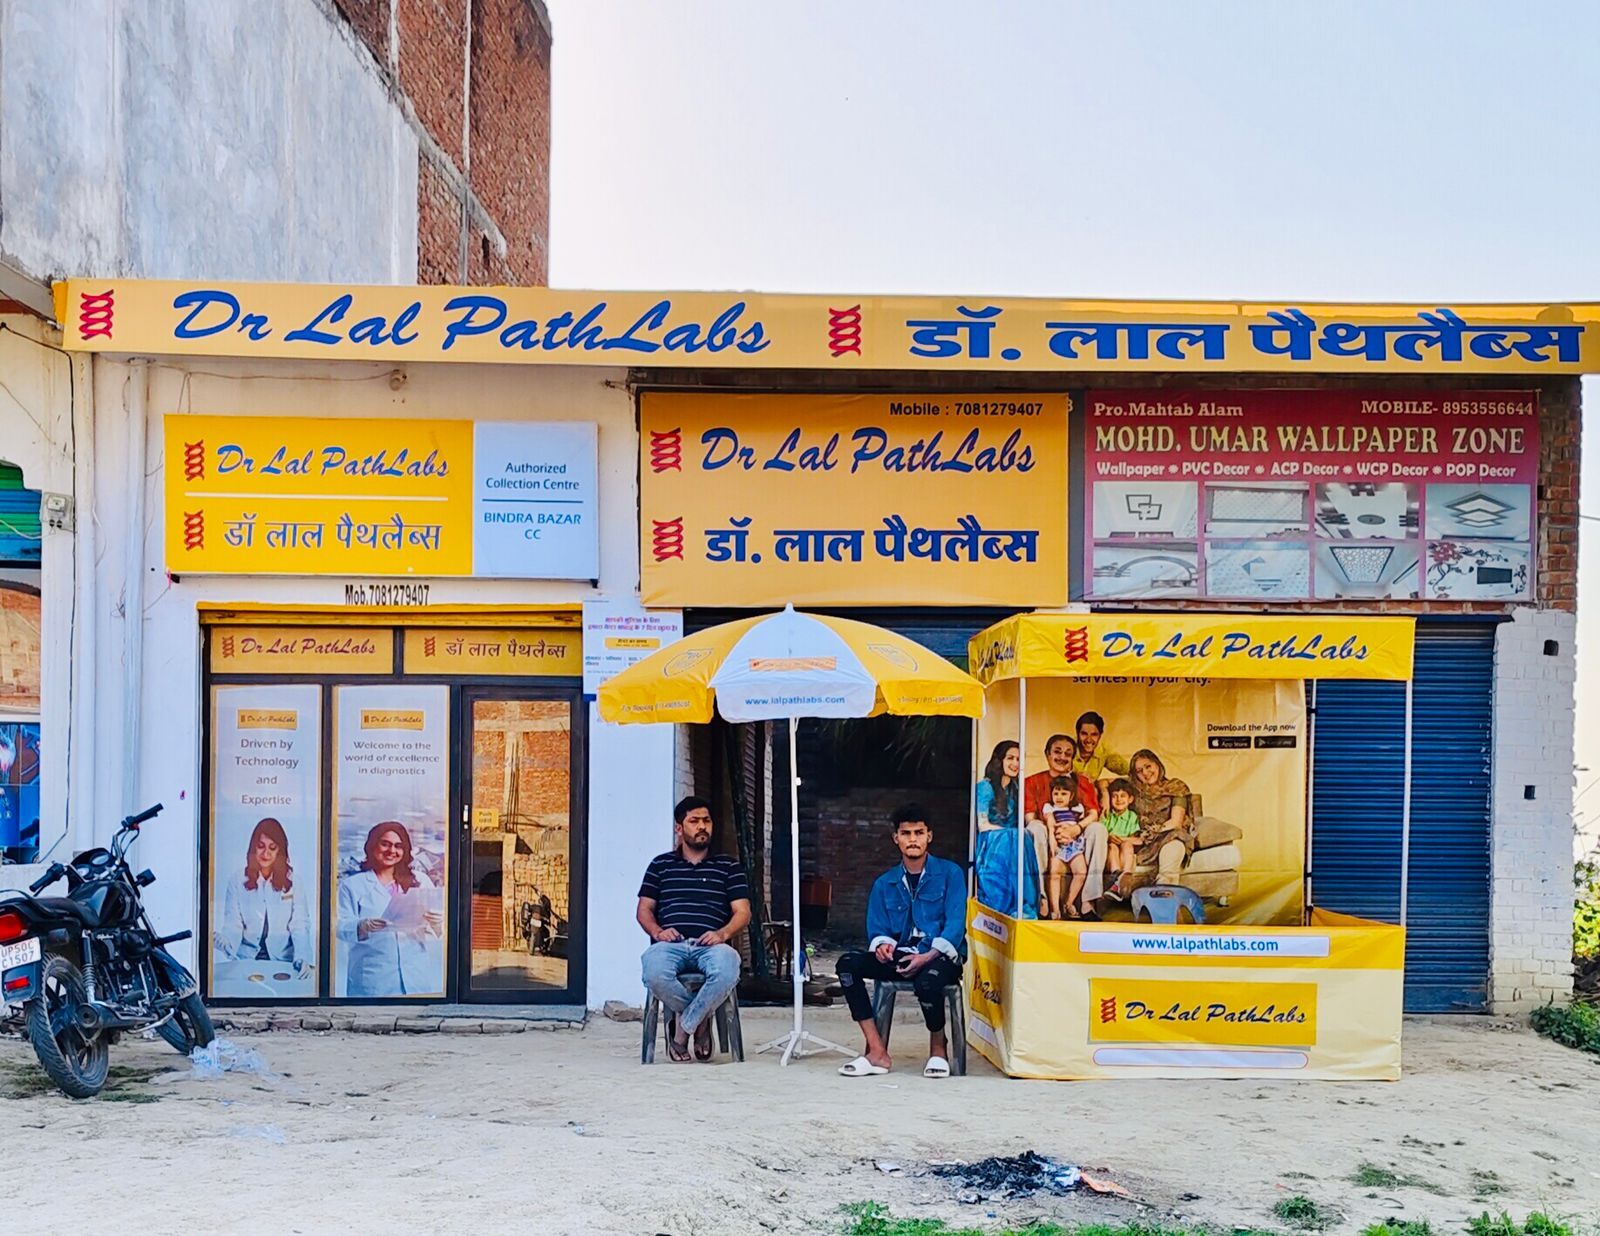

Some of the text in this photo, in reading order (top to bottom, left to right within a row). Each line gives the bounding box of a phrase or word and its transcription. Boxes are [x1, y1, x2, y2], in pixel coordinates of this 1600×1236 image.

[172, 289, 771, 354] Dr Lal PathLabs
[906, 305, 1585, 363] डॉ. लाल पैथलैब्स
[889, 402, 940, 416] Mobile
[954, 402, 1043, 417] 7081279407
[1198, 402, 1244, 417] Alam
[1442, 401, 1533, 416] 8953556644
[1095, 425, 1525, 454] MOHD. UMAR WALLPAPER ZONE
[700, 427, 1036, 474] Dr Lal PathLabs
[216, 444, 450, 478] Dr Lal PathLabs
[505, 461, 567, 474] Authorized
[1096, 461, 1517, 478] Wallpaper PVC Decor ACP Decor WCP Decor POP Decor
[485, 478, 580, 491] Collection Centre
[483, 512, 582, 525] BINDRA BAZAR
[223, 512, 443, 550] डॉ लाल पैथलैब्स
[524, 529, 542, 540] CC
[704, 514, 1039, 564] डॉ. लाल पैथलैब्स
[240, 637, 377, 655] Dr Lal PathLabs
[446, 637, 568, 659] डॉ लाल पैथलैब्स
[1102, 631, 1370, 661] Dr Lal PathLabs
[744, 695, 846, 706] www.lalpathlabs.com
[1207, 723, 1247, 732] Download
[1248, 724, 1262, 732] the
[1263, 724, 1278, 732] App
[240, 738, 294, 751] Driven by
[353, 741, 432, 751] Welcome to the
[235, 756, 300, 770] Technology
[344, 753, 440, 763] world of excellence
[358, 766, 426, 777] in diagnostics
[256, 776, 278, 786] and
[241, 794, 292, 807] Expertise
[1131, 936, 1279, 953] www.lalpathlabs.com
[1125, 1000, 1307, 1024] Dr Lal PathLabs
